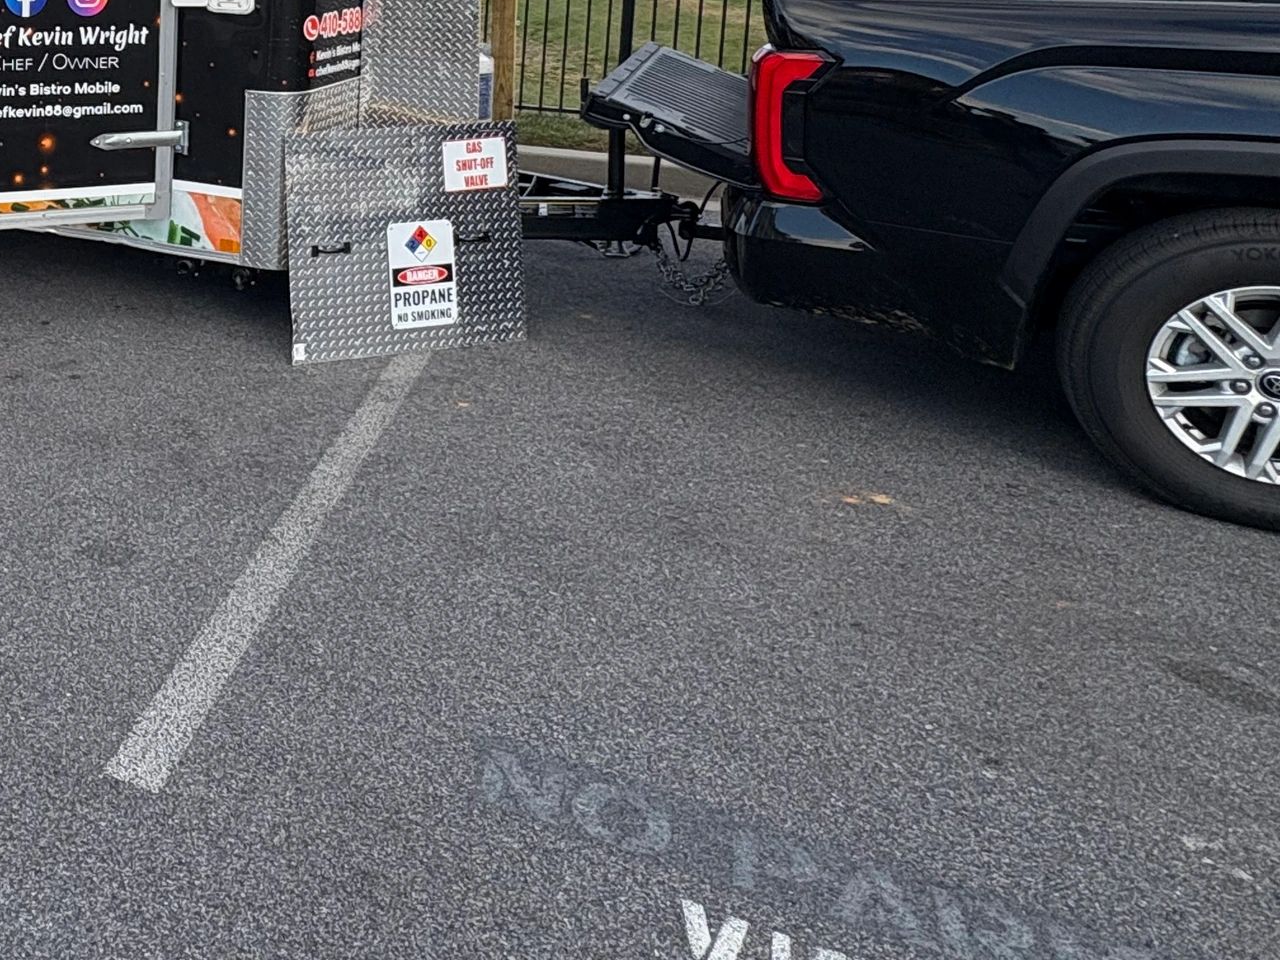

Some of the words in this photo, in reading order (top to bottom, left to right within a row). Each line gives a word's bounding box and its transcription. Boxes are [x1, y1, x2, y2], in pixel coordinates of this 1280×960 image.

[320, 7, 362, 38] 410-588
[18, 26, 74, 47] Kevin
[79, 23, 149, 51] Wright
[37, 52, 49, 73] /
[52, 53, 120, 71] OWNER
[30, 82, 71, 96] Bistro
[74, 81, 120, 94] Mobile
[466, 141, 483, 154] GAS
[456, 157, 495, 171] SHUT-OFF
[464, 174, 489, 187] VALVE
[406, 269, 439, 281] DANGER
[394, 288, 454, 307] PROPANE
[397, 311, 409, 323] NO
[411, 308, 452, 322] SMOKING
